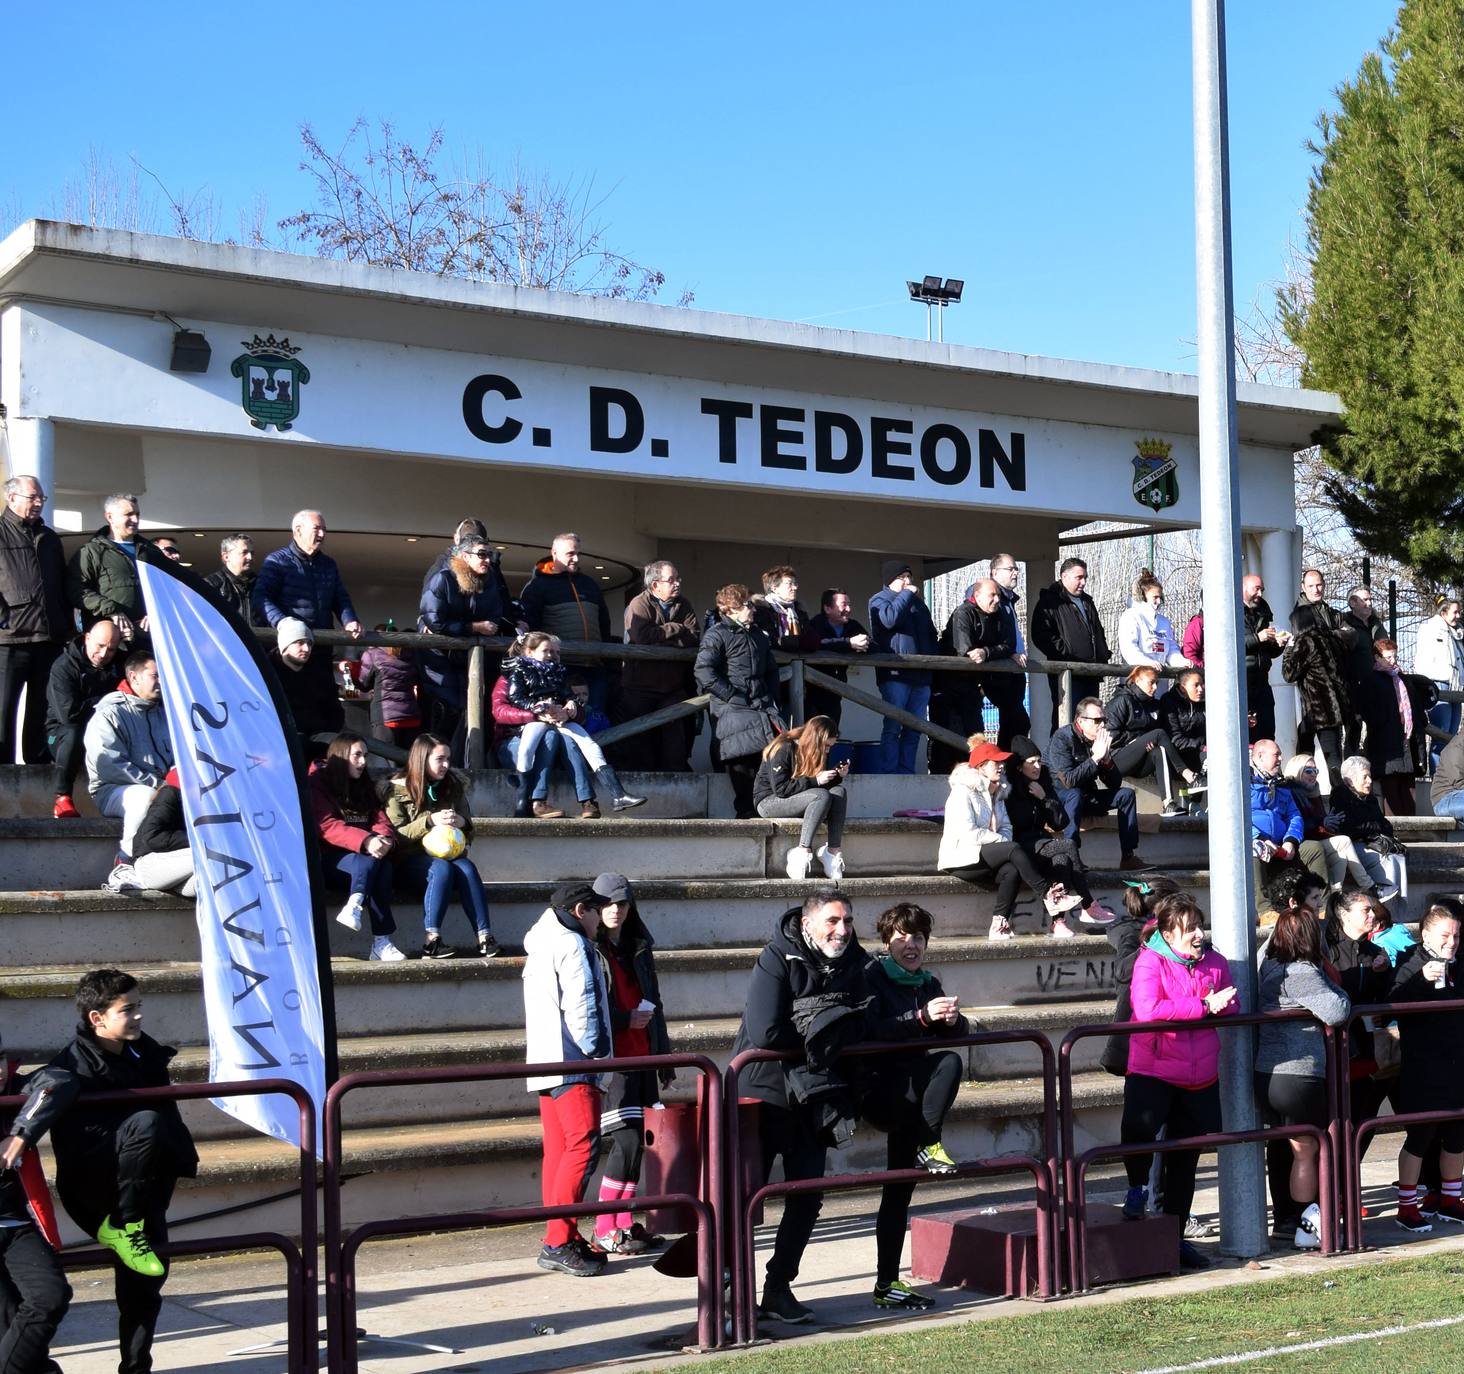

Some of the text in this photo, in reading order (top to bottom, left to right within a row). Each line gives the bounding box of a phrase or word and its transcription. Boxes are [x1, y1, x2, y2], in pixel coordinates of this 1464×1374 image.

[462, 374, 1027, 492] C. D. TEDEON
[1151, 463, 1173, 480] TEDEON
